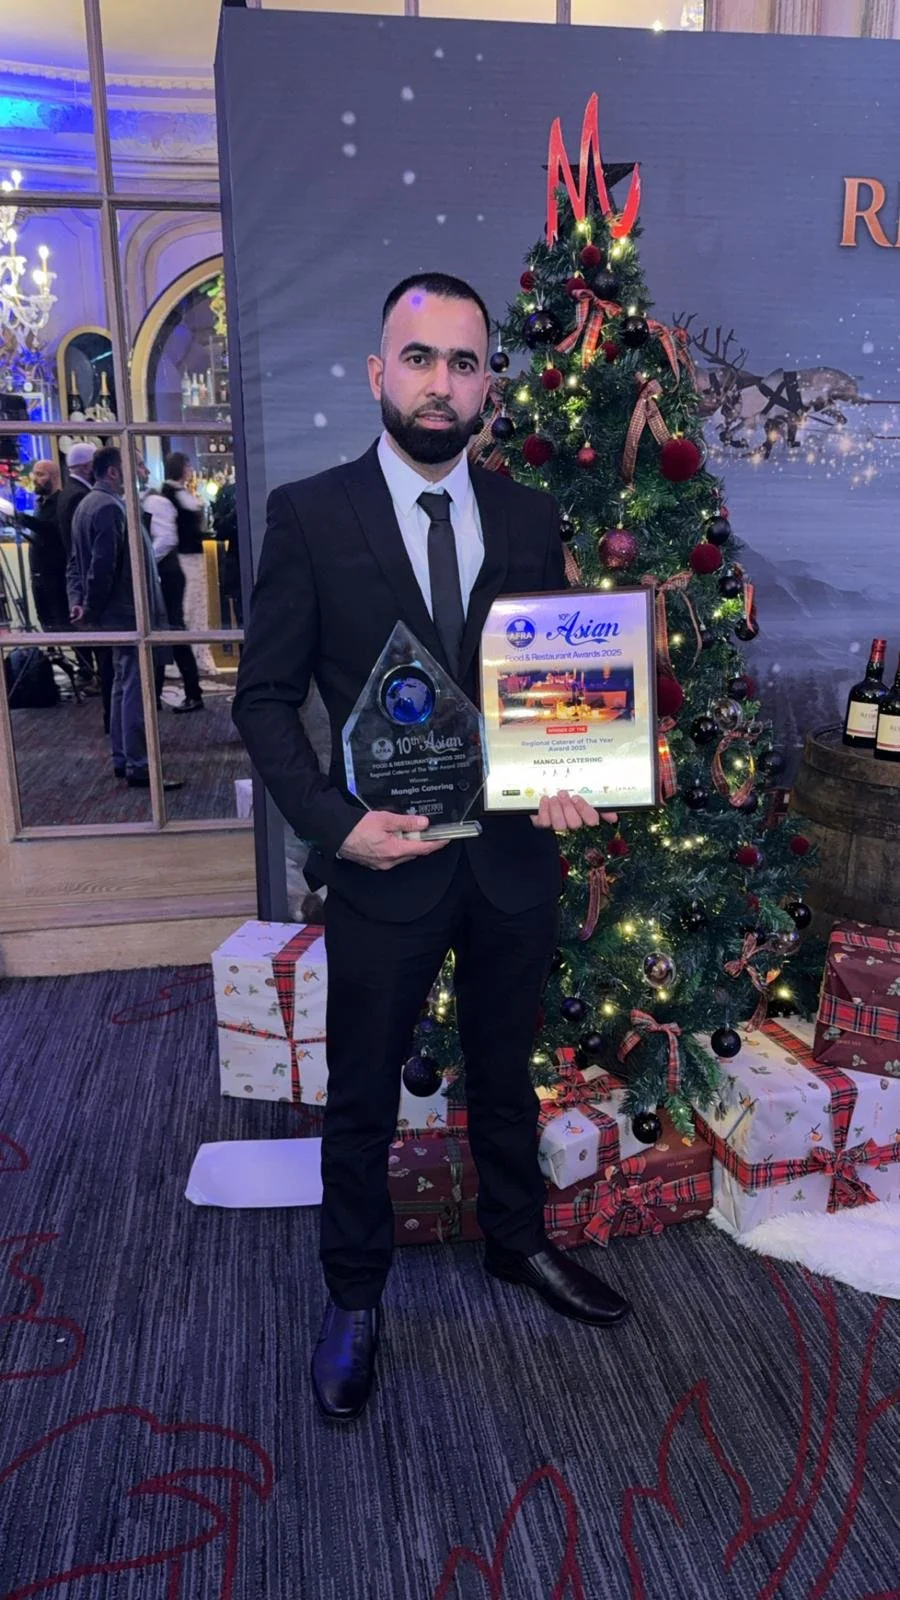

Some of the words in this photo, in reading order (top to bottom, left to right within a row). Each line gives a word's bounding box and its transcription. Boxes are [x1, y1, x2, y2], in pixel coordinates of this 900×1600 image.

[840, 177, 900, 248] R
[546, 611, 619, 646] Asian
[505, 654, 524, 662] Food
[525, 653, 530, 661] &
[532, 651, 571, 661] Restaurant
[573, 650, 600, 658] Awards
[602, 648, 622, 657] 2025
[396, 736, 420, 755] 10th
[420, 730, 464, 754] Asian
[567, 756, 603, 764] CATERING
[391, 786, 420, 795] Mangla
[421, 783, 454, 792] Catering
